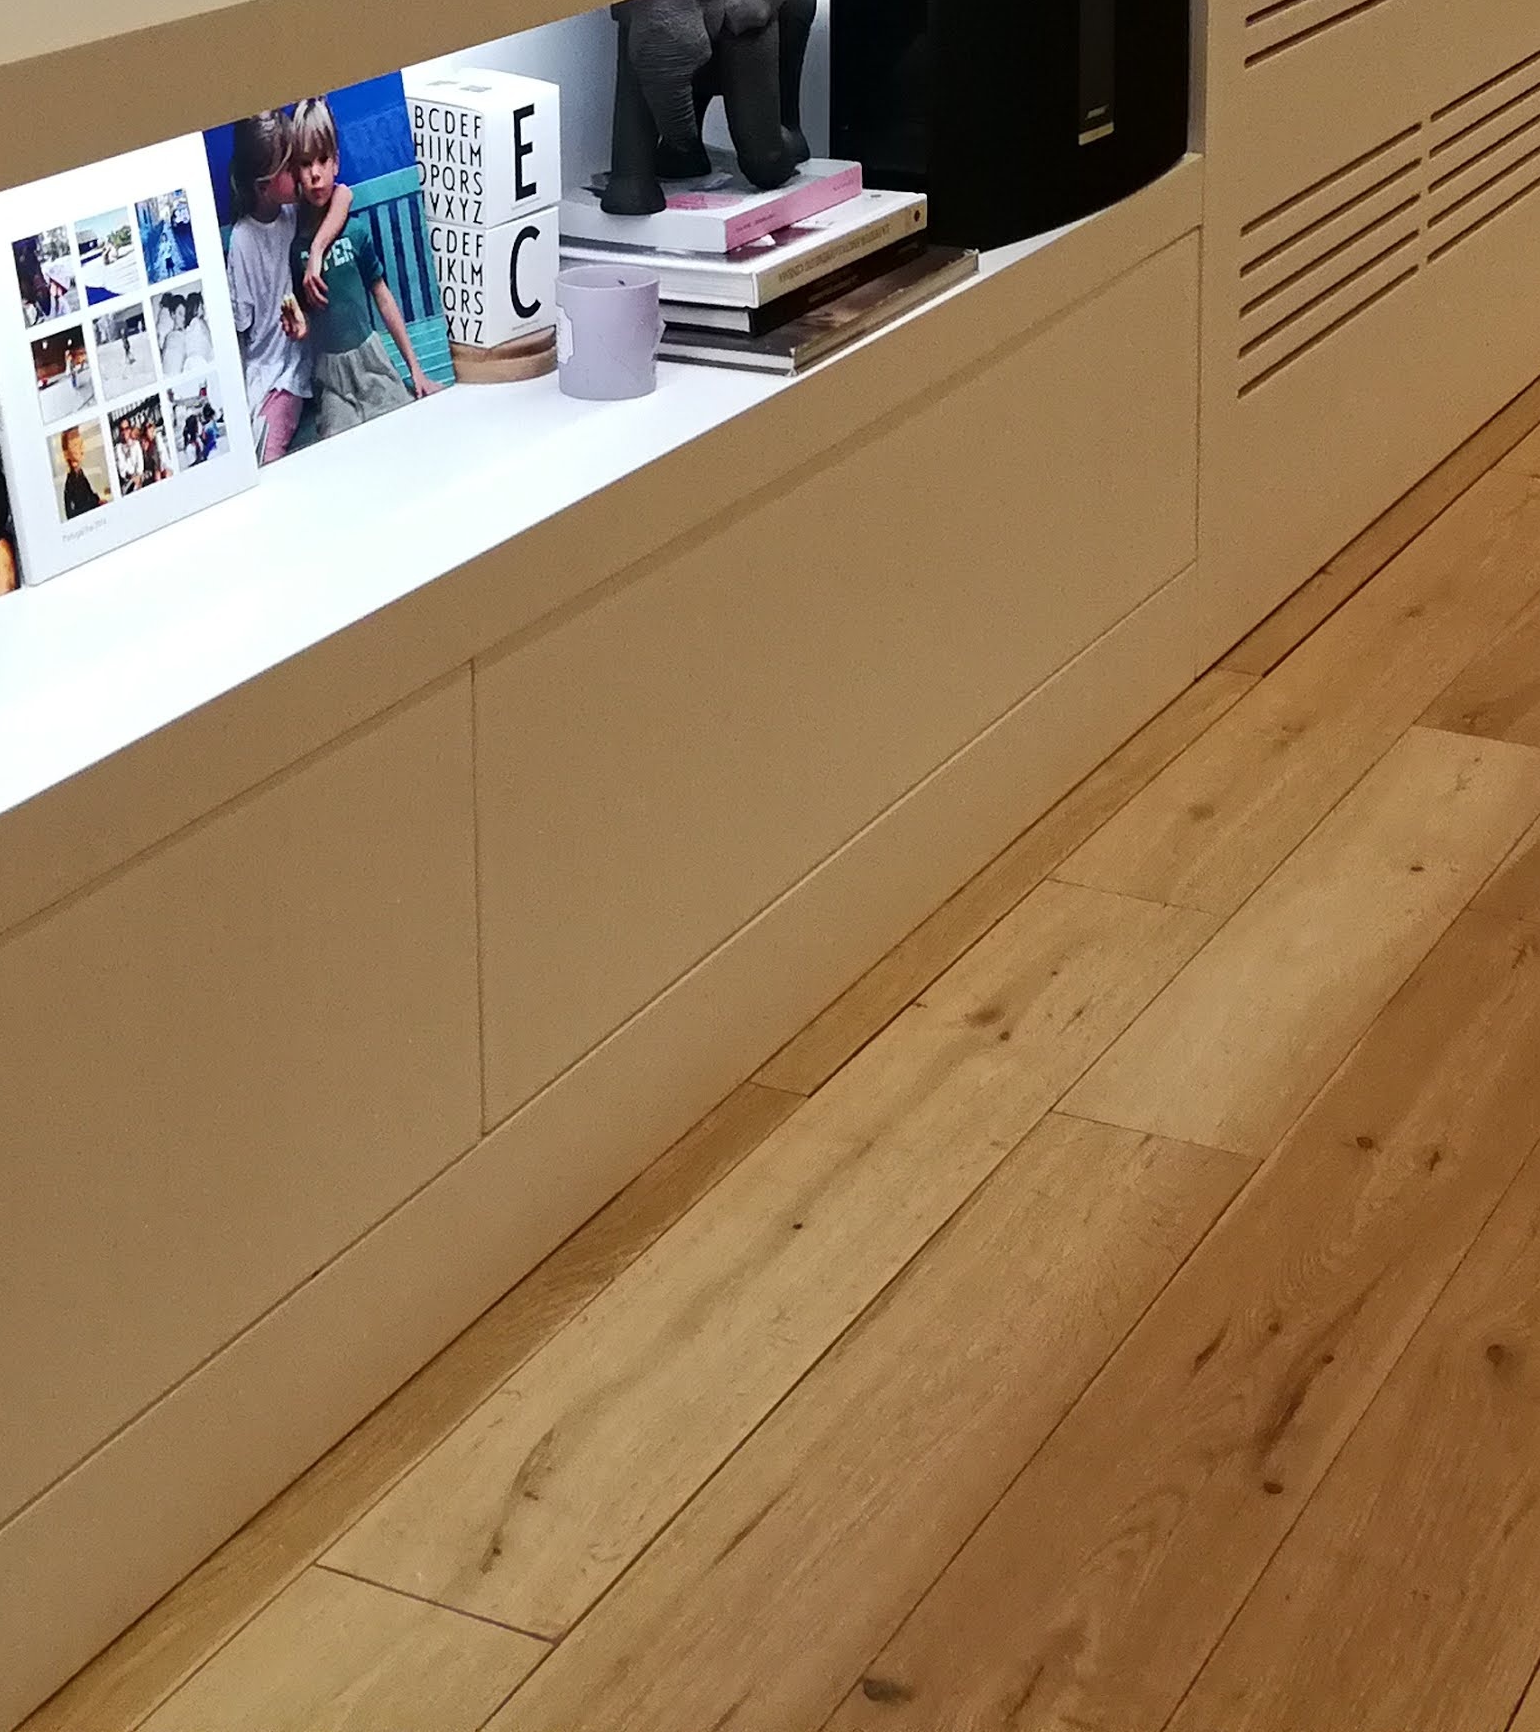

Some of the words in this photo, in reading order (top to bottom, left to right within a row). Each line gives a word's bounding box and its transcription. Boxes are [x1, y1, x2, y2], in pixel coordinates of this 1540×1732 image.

[513, 103, 537, 202] E
[431, 227, 483, 258] CDEF
[510, 225, 541, 319] C
